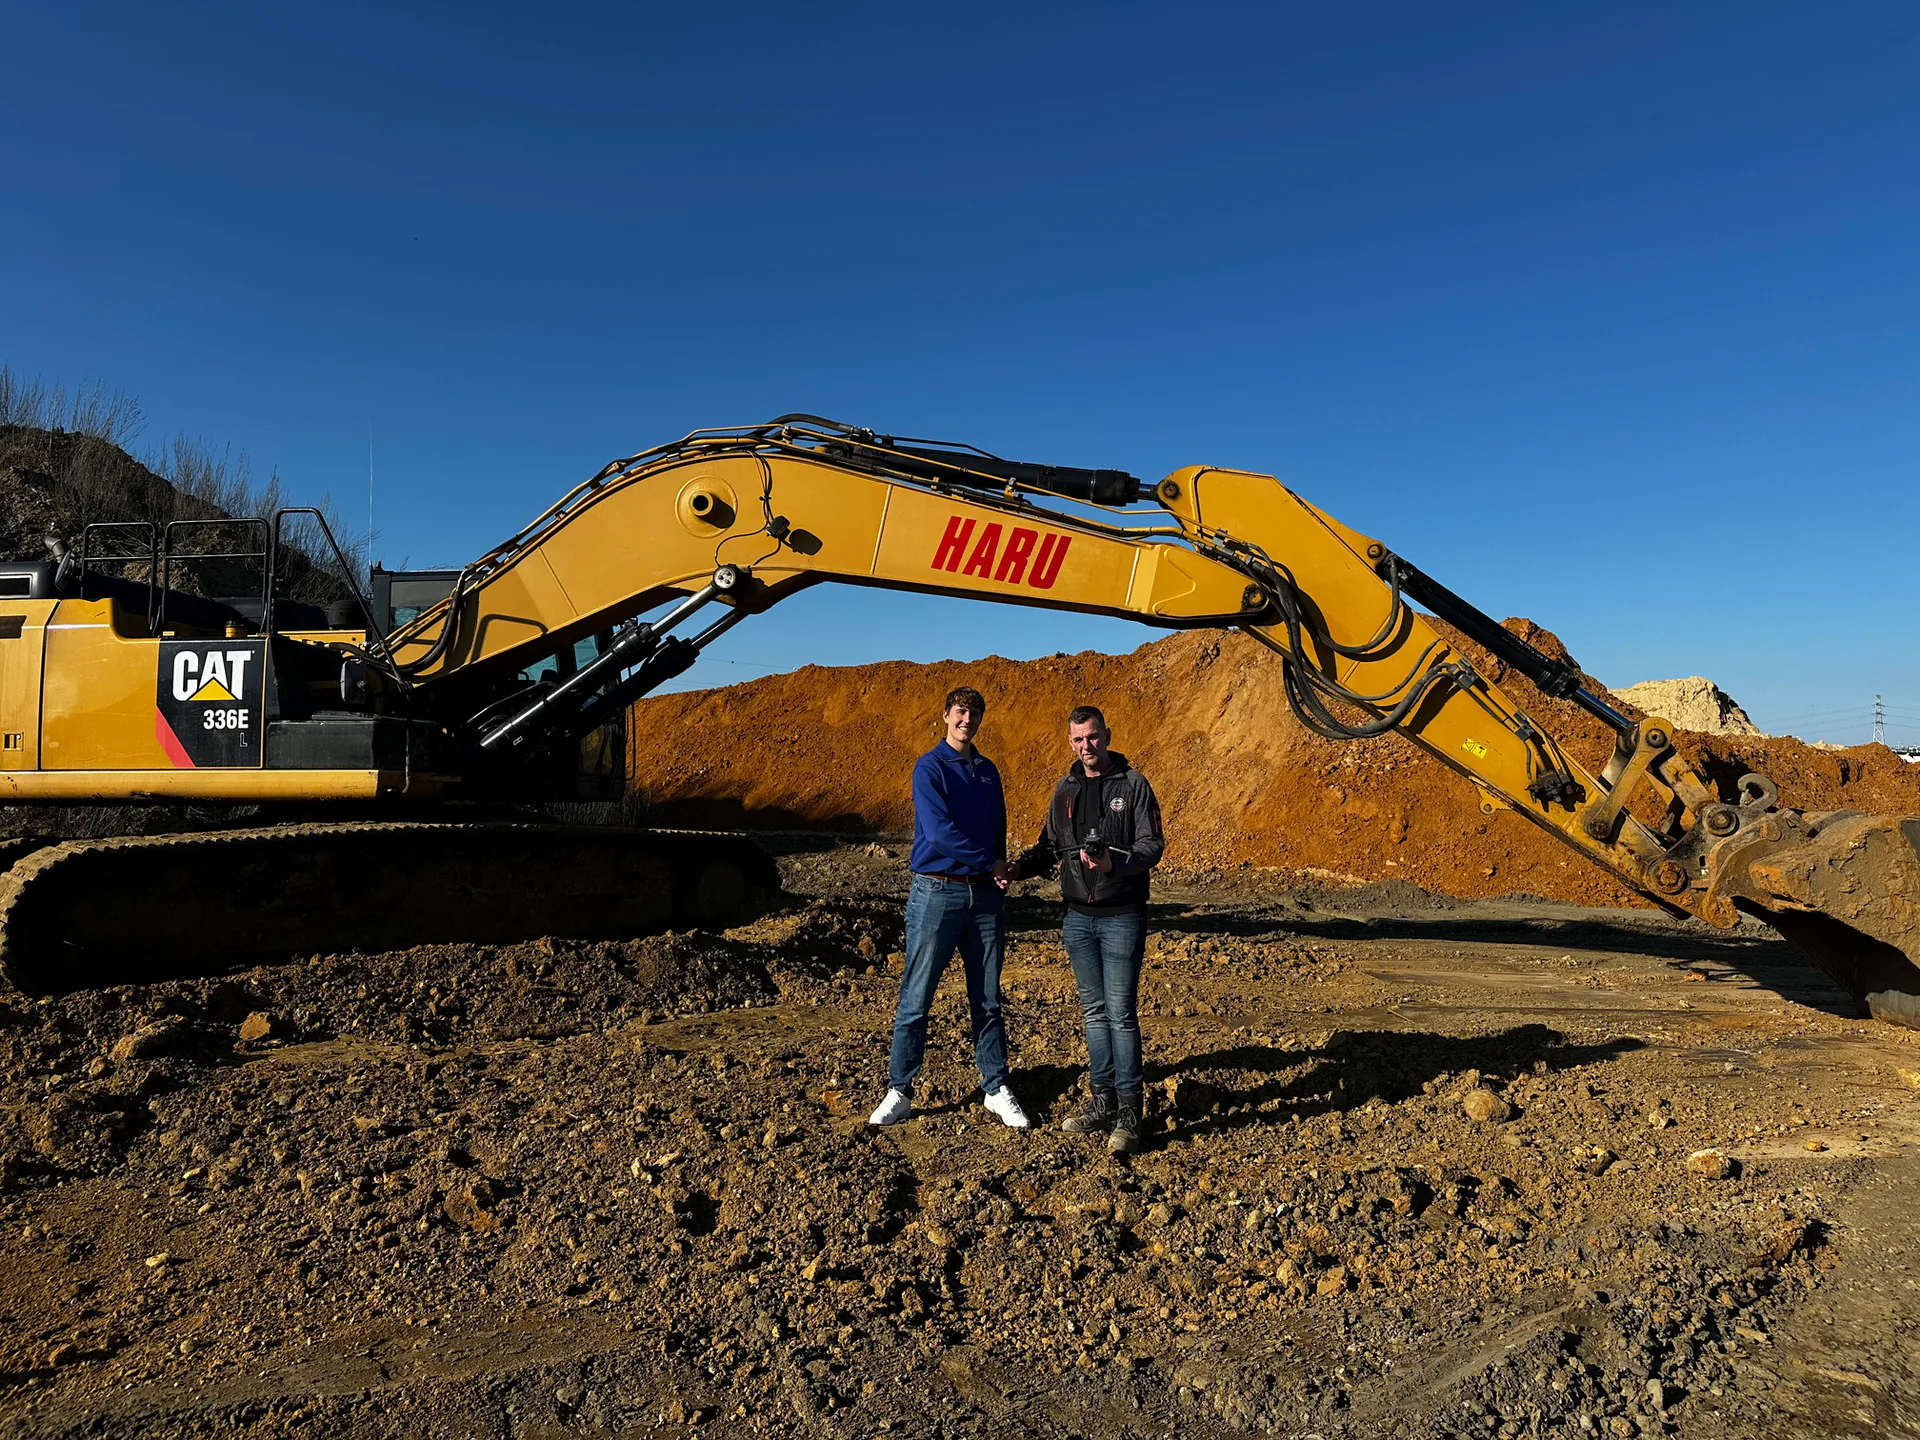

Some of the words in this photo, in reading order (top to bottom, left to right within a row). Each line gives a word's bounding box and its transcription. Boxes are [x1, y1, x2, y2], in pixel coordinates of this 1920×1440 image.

[931, 515, 1072, 589] HARU
[173, 650, 252, 701] CAT
[203, 709, 249, 730] 336E
[240, 732, 248, 747] L
